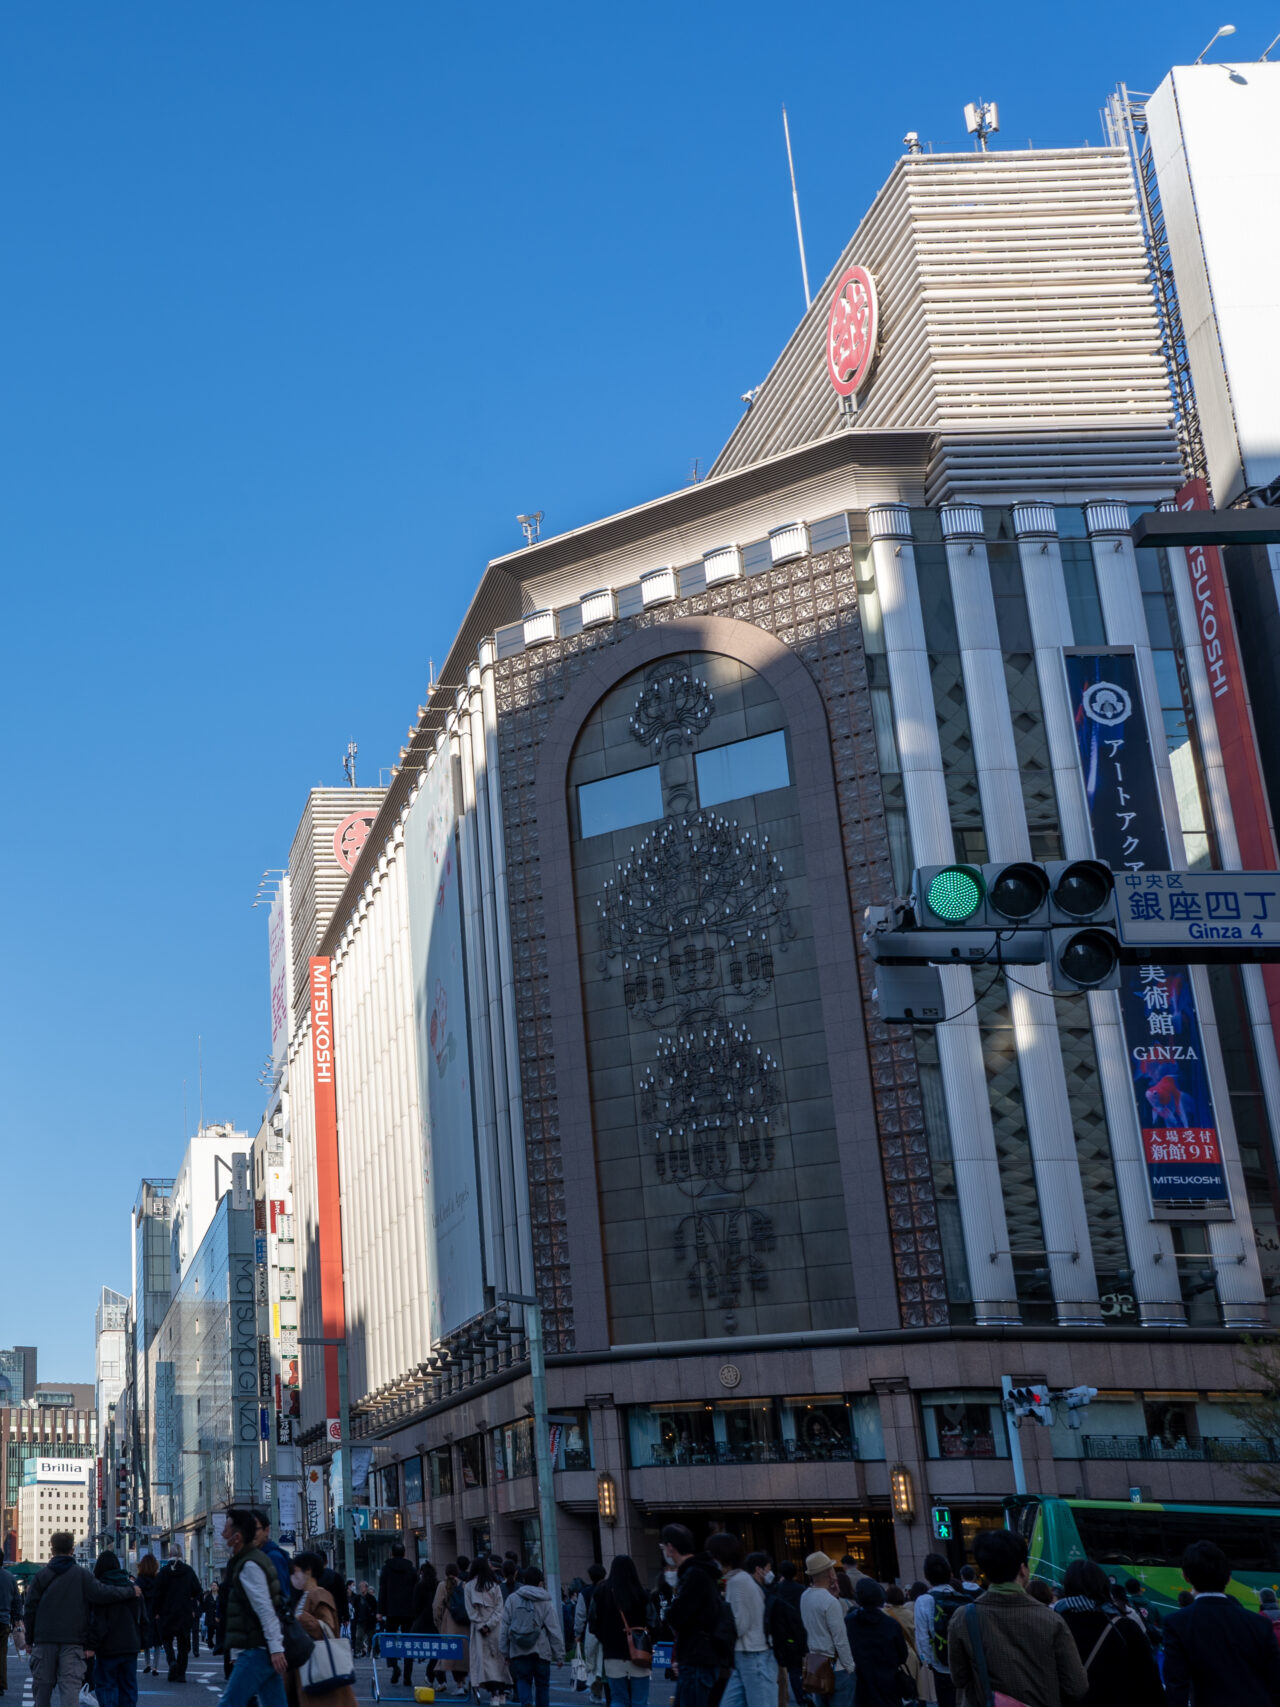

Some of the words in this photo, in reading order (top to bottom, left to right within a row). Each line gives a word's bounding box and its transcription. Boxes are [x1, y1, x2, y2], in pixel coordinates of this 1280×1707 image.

[1124, 874, 1184, 889] 中央区
[1129, 891, 1277, 921] 銀座四丁
[1188, 923, 1242, 939] Ginza
[1250, 923, 1263, 939] 4
[313, 965, 332, 1083] MITSUKOSHI
[1133, 1046, 1199, 1061] GINZA
[1150, 1131, 1211, 1144] 入場受付
[1152, 1175, 1221, 1186] MITSUKOSHI
[41, 1463, 82, 1473] Brillia
